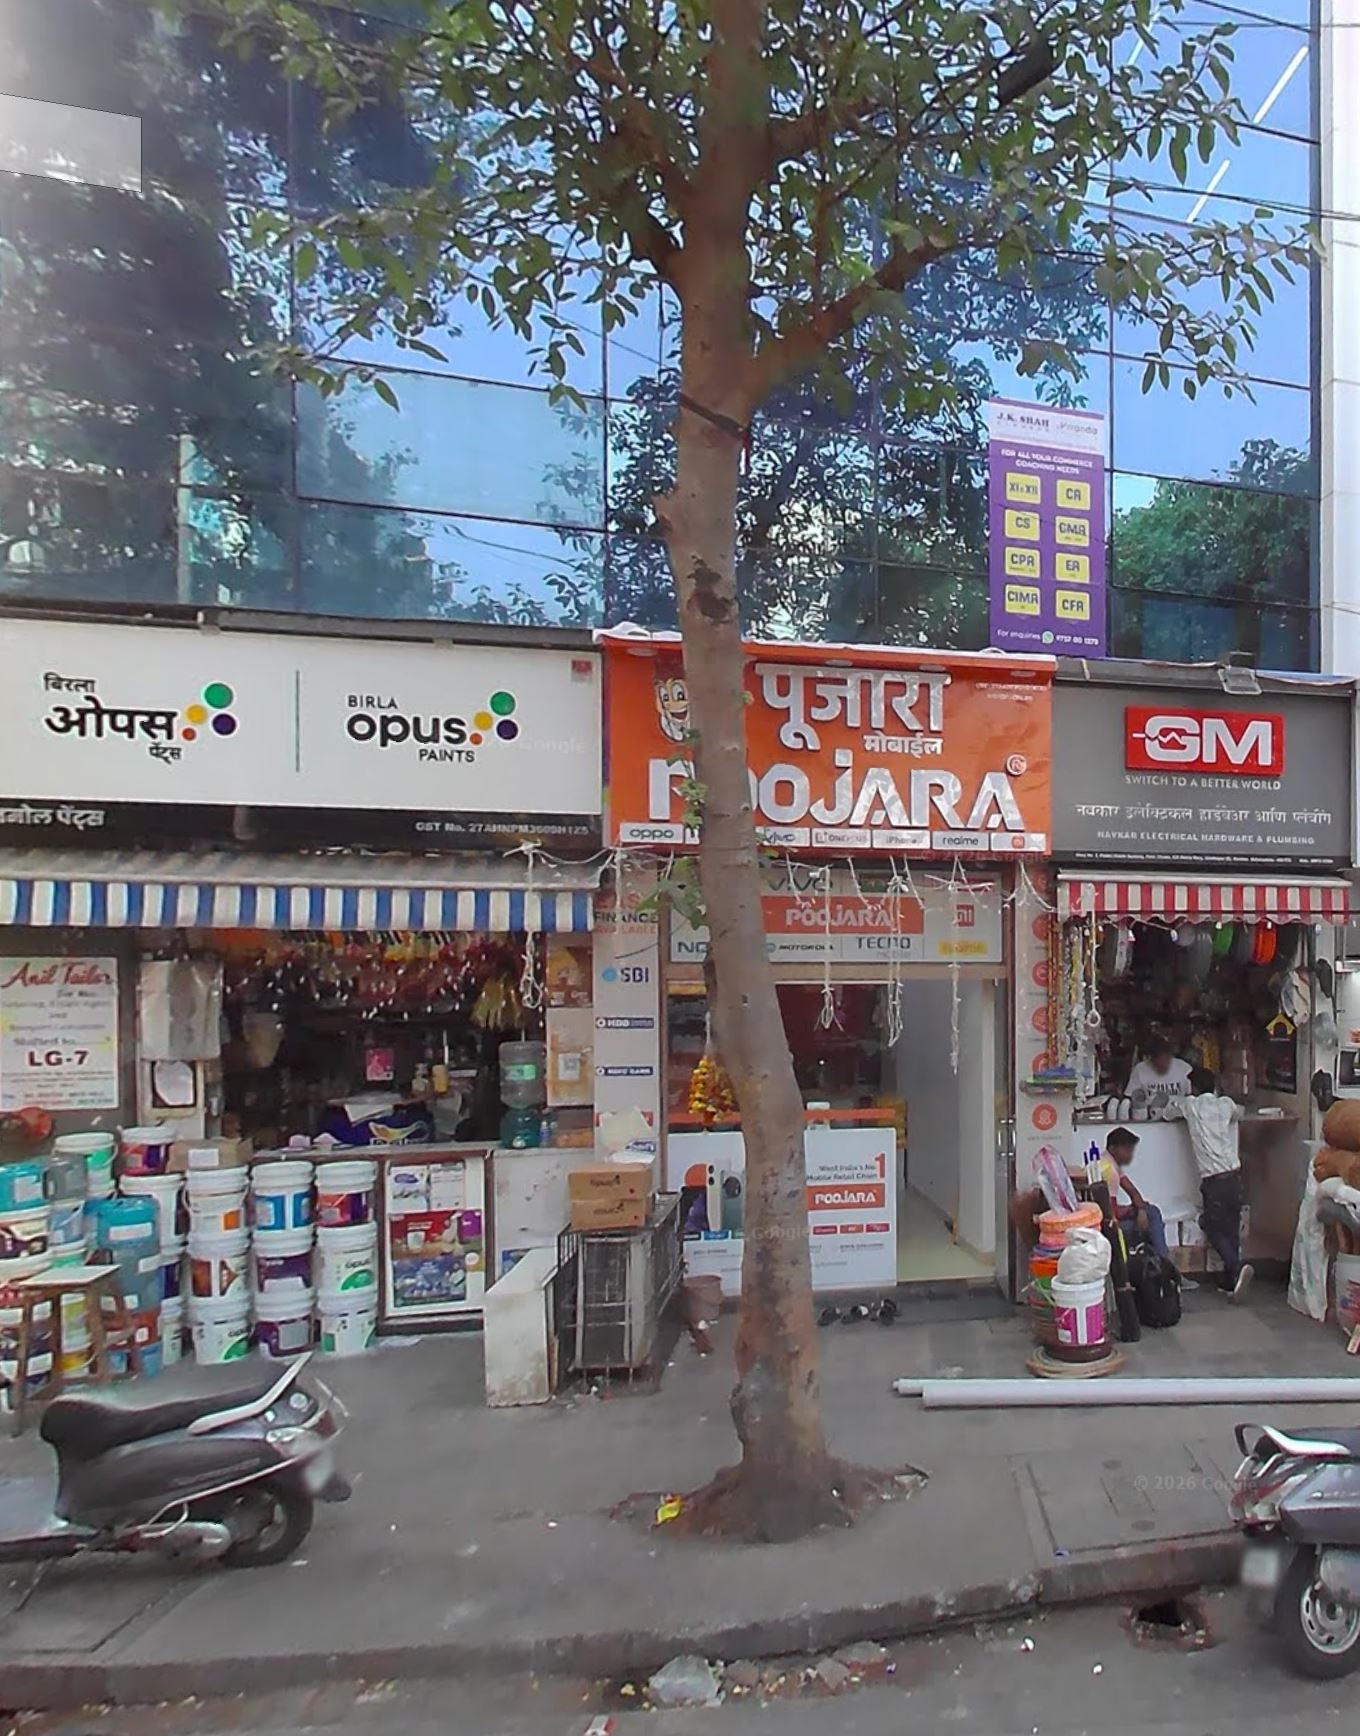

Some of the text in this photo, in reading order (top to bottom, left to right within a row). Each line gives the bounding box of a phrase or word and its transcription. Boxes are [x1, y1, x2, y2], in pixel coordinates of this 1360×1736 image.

[1020, 416, 1050, 428] SHAH
[1001, 448, 1016, 457] FOR
[1018, 451, 1031, 459] ALL
[1052, 456, 1093, 468] COMMERCE
[1015, 459, 1079, 474] COACHING NEEDS
[1066, 487, 1081, 501] CA
[1015, 517, 1031, 529] CS
[1059, 522, 1086, 536] CMA
[1010, 553, 1035, 567] CPA
[1065, 560, 1080, 572] EA
[1007, 590, 1039, 604] CIMA
[1062, 599, 1084, 612] CFA
[43, 672, 96, 693] बिरला
[347, 694, 399, 710] BIRLA
[755, 662, 952, 751] पूजारा
[43, 696, 178, 742] ओपस
[346, 712, 468, 748] opus
[863, 732, 945, 759] मोबाईल
[1144, 715, 1273, 767] GM
[148, 741, 183, 764] पेंट्स
[418, 749, 476, 763] PAINTS
[1124, 775, 1282, 790] SWITCH TO A BETTER WORLD
[1075, 804, 1120, 817] नवकार
[1254, 806, 1287, 823] आणि
[415, 822, 441, 832] GST
[629, 828, 675, 841] oppo
[942, 835, 979, 846] realme
[1097, 831, 1138, 839] NAVKAR
[1140, 832, 1199, 842] ELECTRICAL
[1201, 833, 1255, 843] HARDWARE
[1266, 835, 1315, 845] PLUMBING
[0, 961, 114, 990] Anil Tailor
[620, 967, 649, 983] SBI
[28, 1050, 90, 1067] LG-7
[874, 1152, 885, 1179] 1
[814, 1190, 876, 1205] POOJARA
